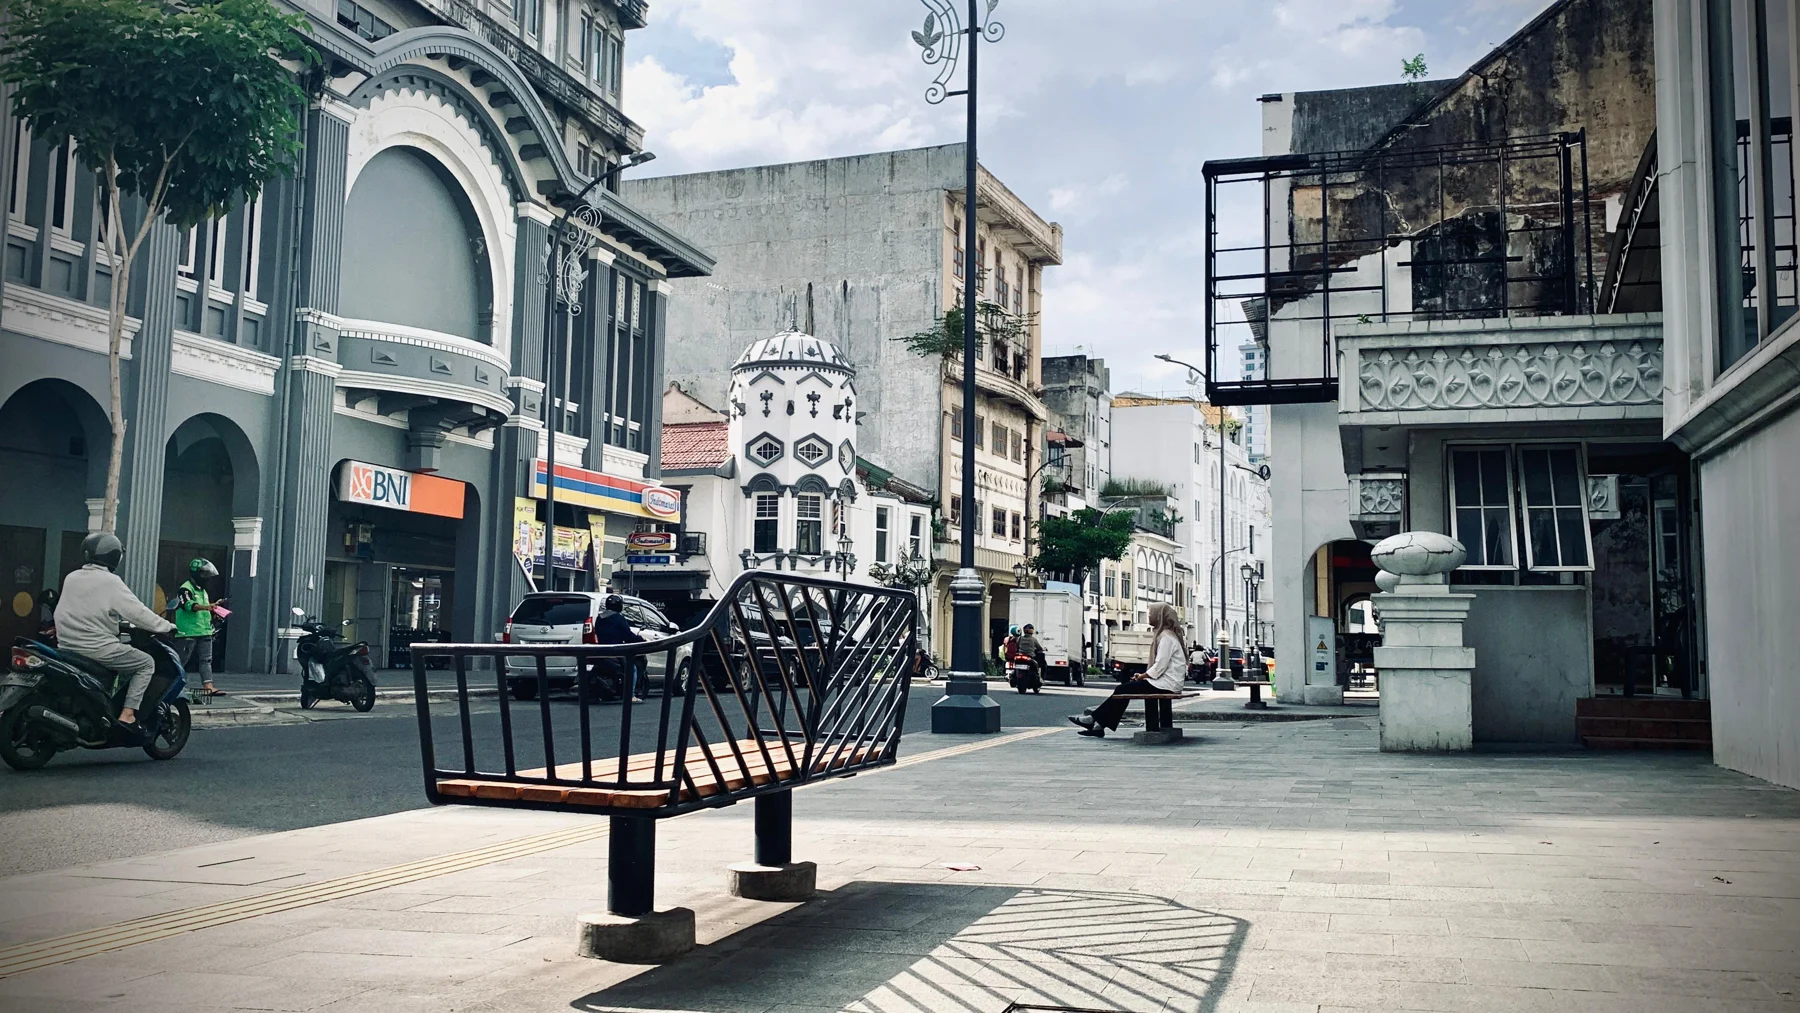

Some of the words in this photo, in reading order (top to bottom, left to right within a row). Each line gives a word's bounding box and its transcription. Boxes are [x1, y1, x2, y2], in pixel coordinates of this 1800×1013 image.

[372, 470, 408, 505] BNI
[650, 493, 675, 510] Indomaret
[636, 536, 664, 544] Indomaret
